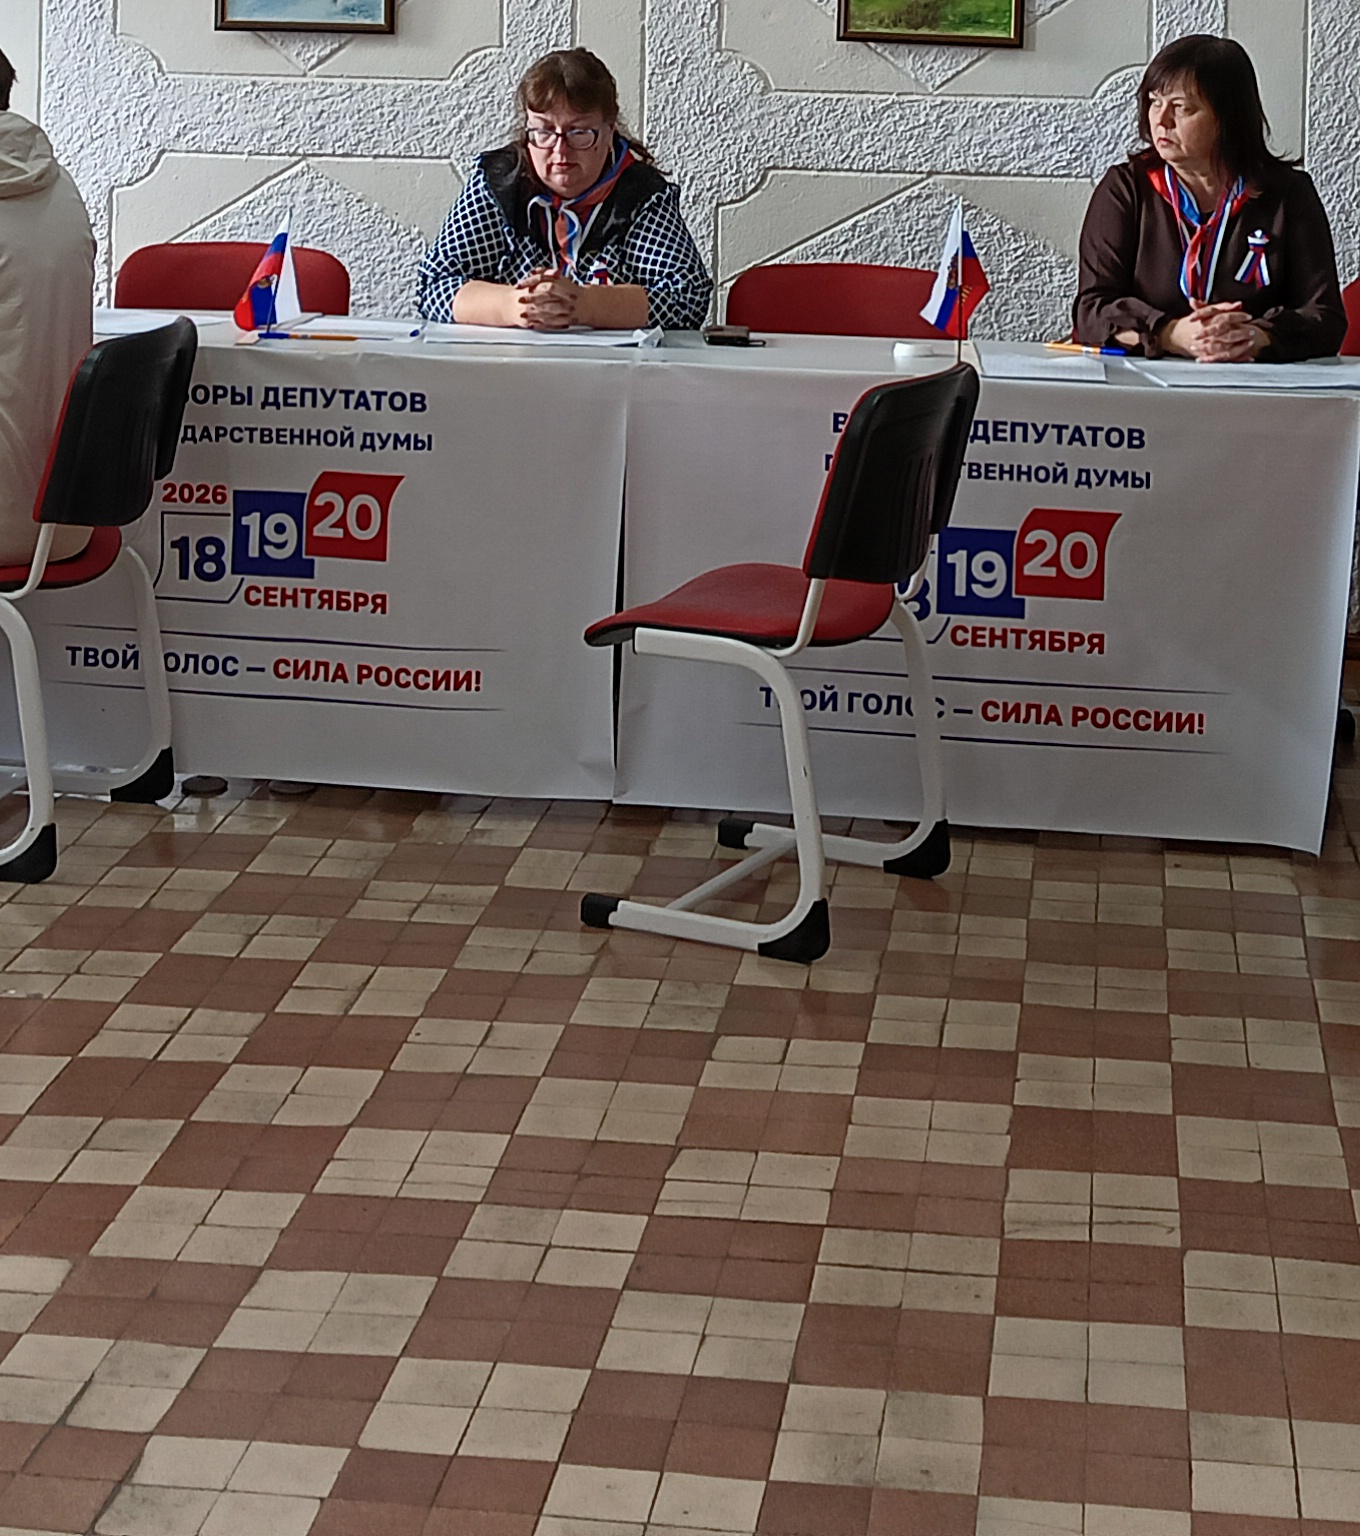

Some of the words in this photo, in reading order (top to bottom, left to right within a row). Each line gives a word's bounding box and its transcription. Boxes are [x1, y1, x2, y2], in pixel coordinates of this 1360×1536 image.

[185, 384, 253, 406] ОРЫ
[260, 386, 428, 413] ДЕПУТАТОВ
[181, 424, 355, 448] ДАРСТВЕННОЙ
[360, 432, 433, 452] ДУМЫ
[969, 419, 1146, 450] ДЕПУТАТОВ
[162, 482, 228, 505] 2026
[1075, 467, 1151, 490] ДУМЫ
[170, 535, 227, 582] 18
[240, 512, 298, 560] 19
[312, 491, 382, 541] 20
[946, 549, 1008, 599] 19
[1023, 529, 1098, 579] 20
[243, 584, 388, 615] СЕНТЯБРЯ
[950, 624, 1105, 655] СЕНТЯБРЯ
[65, 643, 140, 670] ТВОЙ
[163, 651, 239, 677] ОЛОС
[273, 658, 349, 684] СИЛА
[357, 665, 482, 692] РОССИИ!
[759, 684, 838, 712] ТОЙ
[980, 699, 1063, 727] СИЛА
[1072, 706, 1205, 735] РОССИИ!
